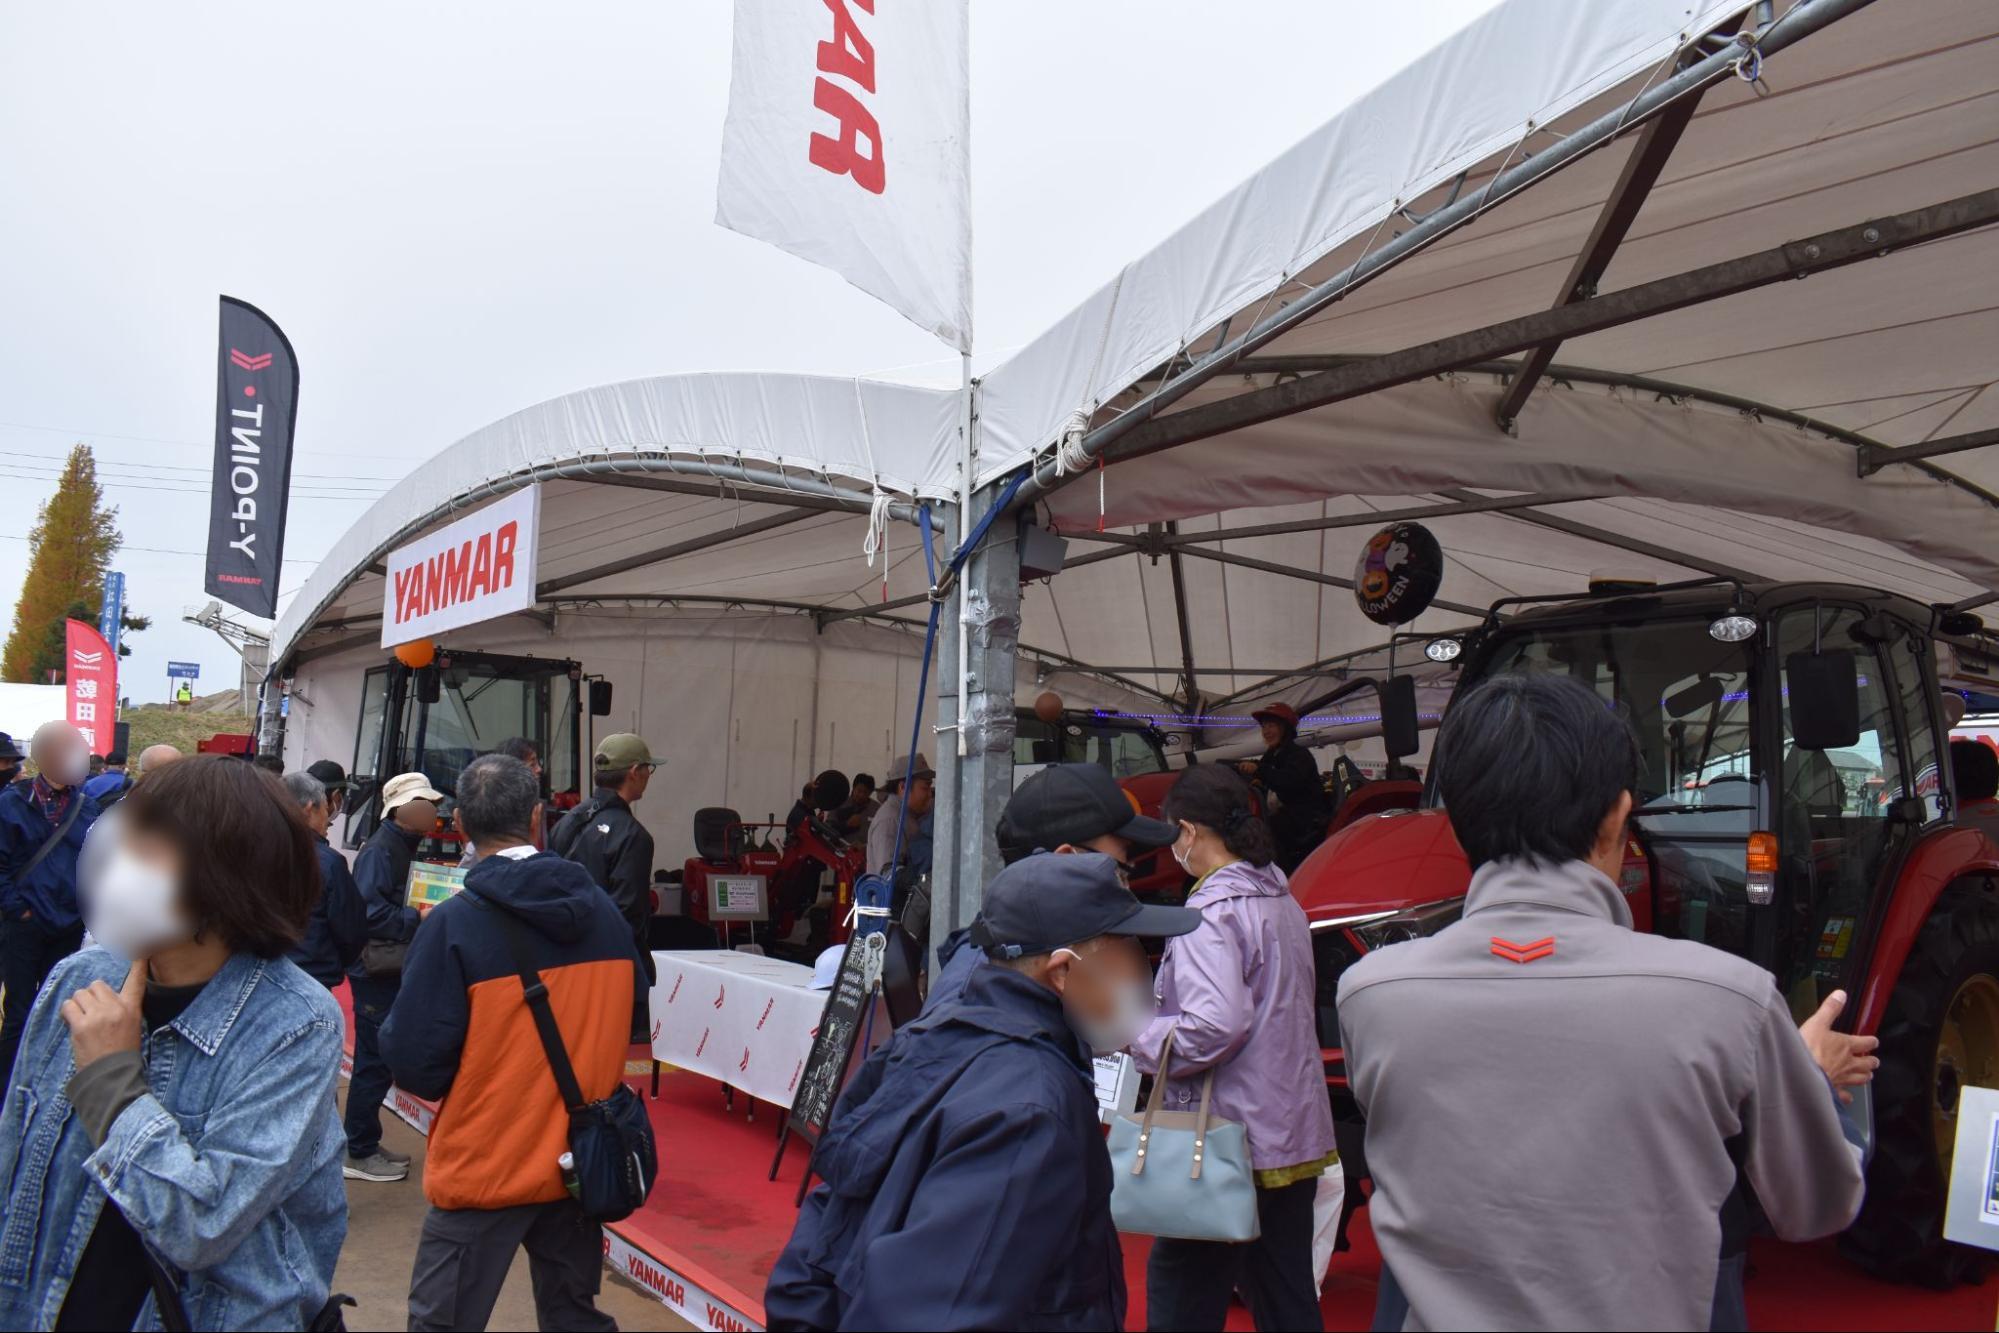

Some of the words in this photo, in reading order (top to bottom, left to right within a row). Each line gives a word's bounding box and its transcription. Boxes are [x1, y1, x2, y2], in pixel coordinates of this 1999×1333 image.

[809, 0, 886, 195] AR
[394, 519, 518, 624] YANMAR
[395, 1094, 420, 1121] YANMAR
[628, 1254, 685, 1308] YANMAR
[706, 1302, 753, 1332] YAN
